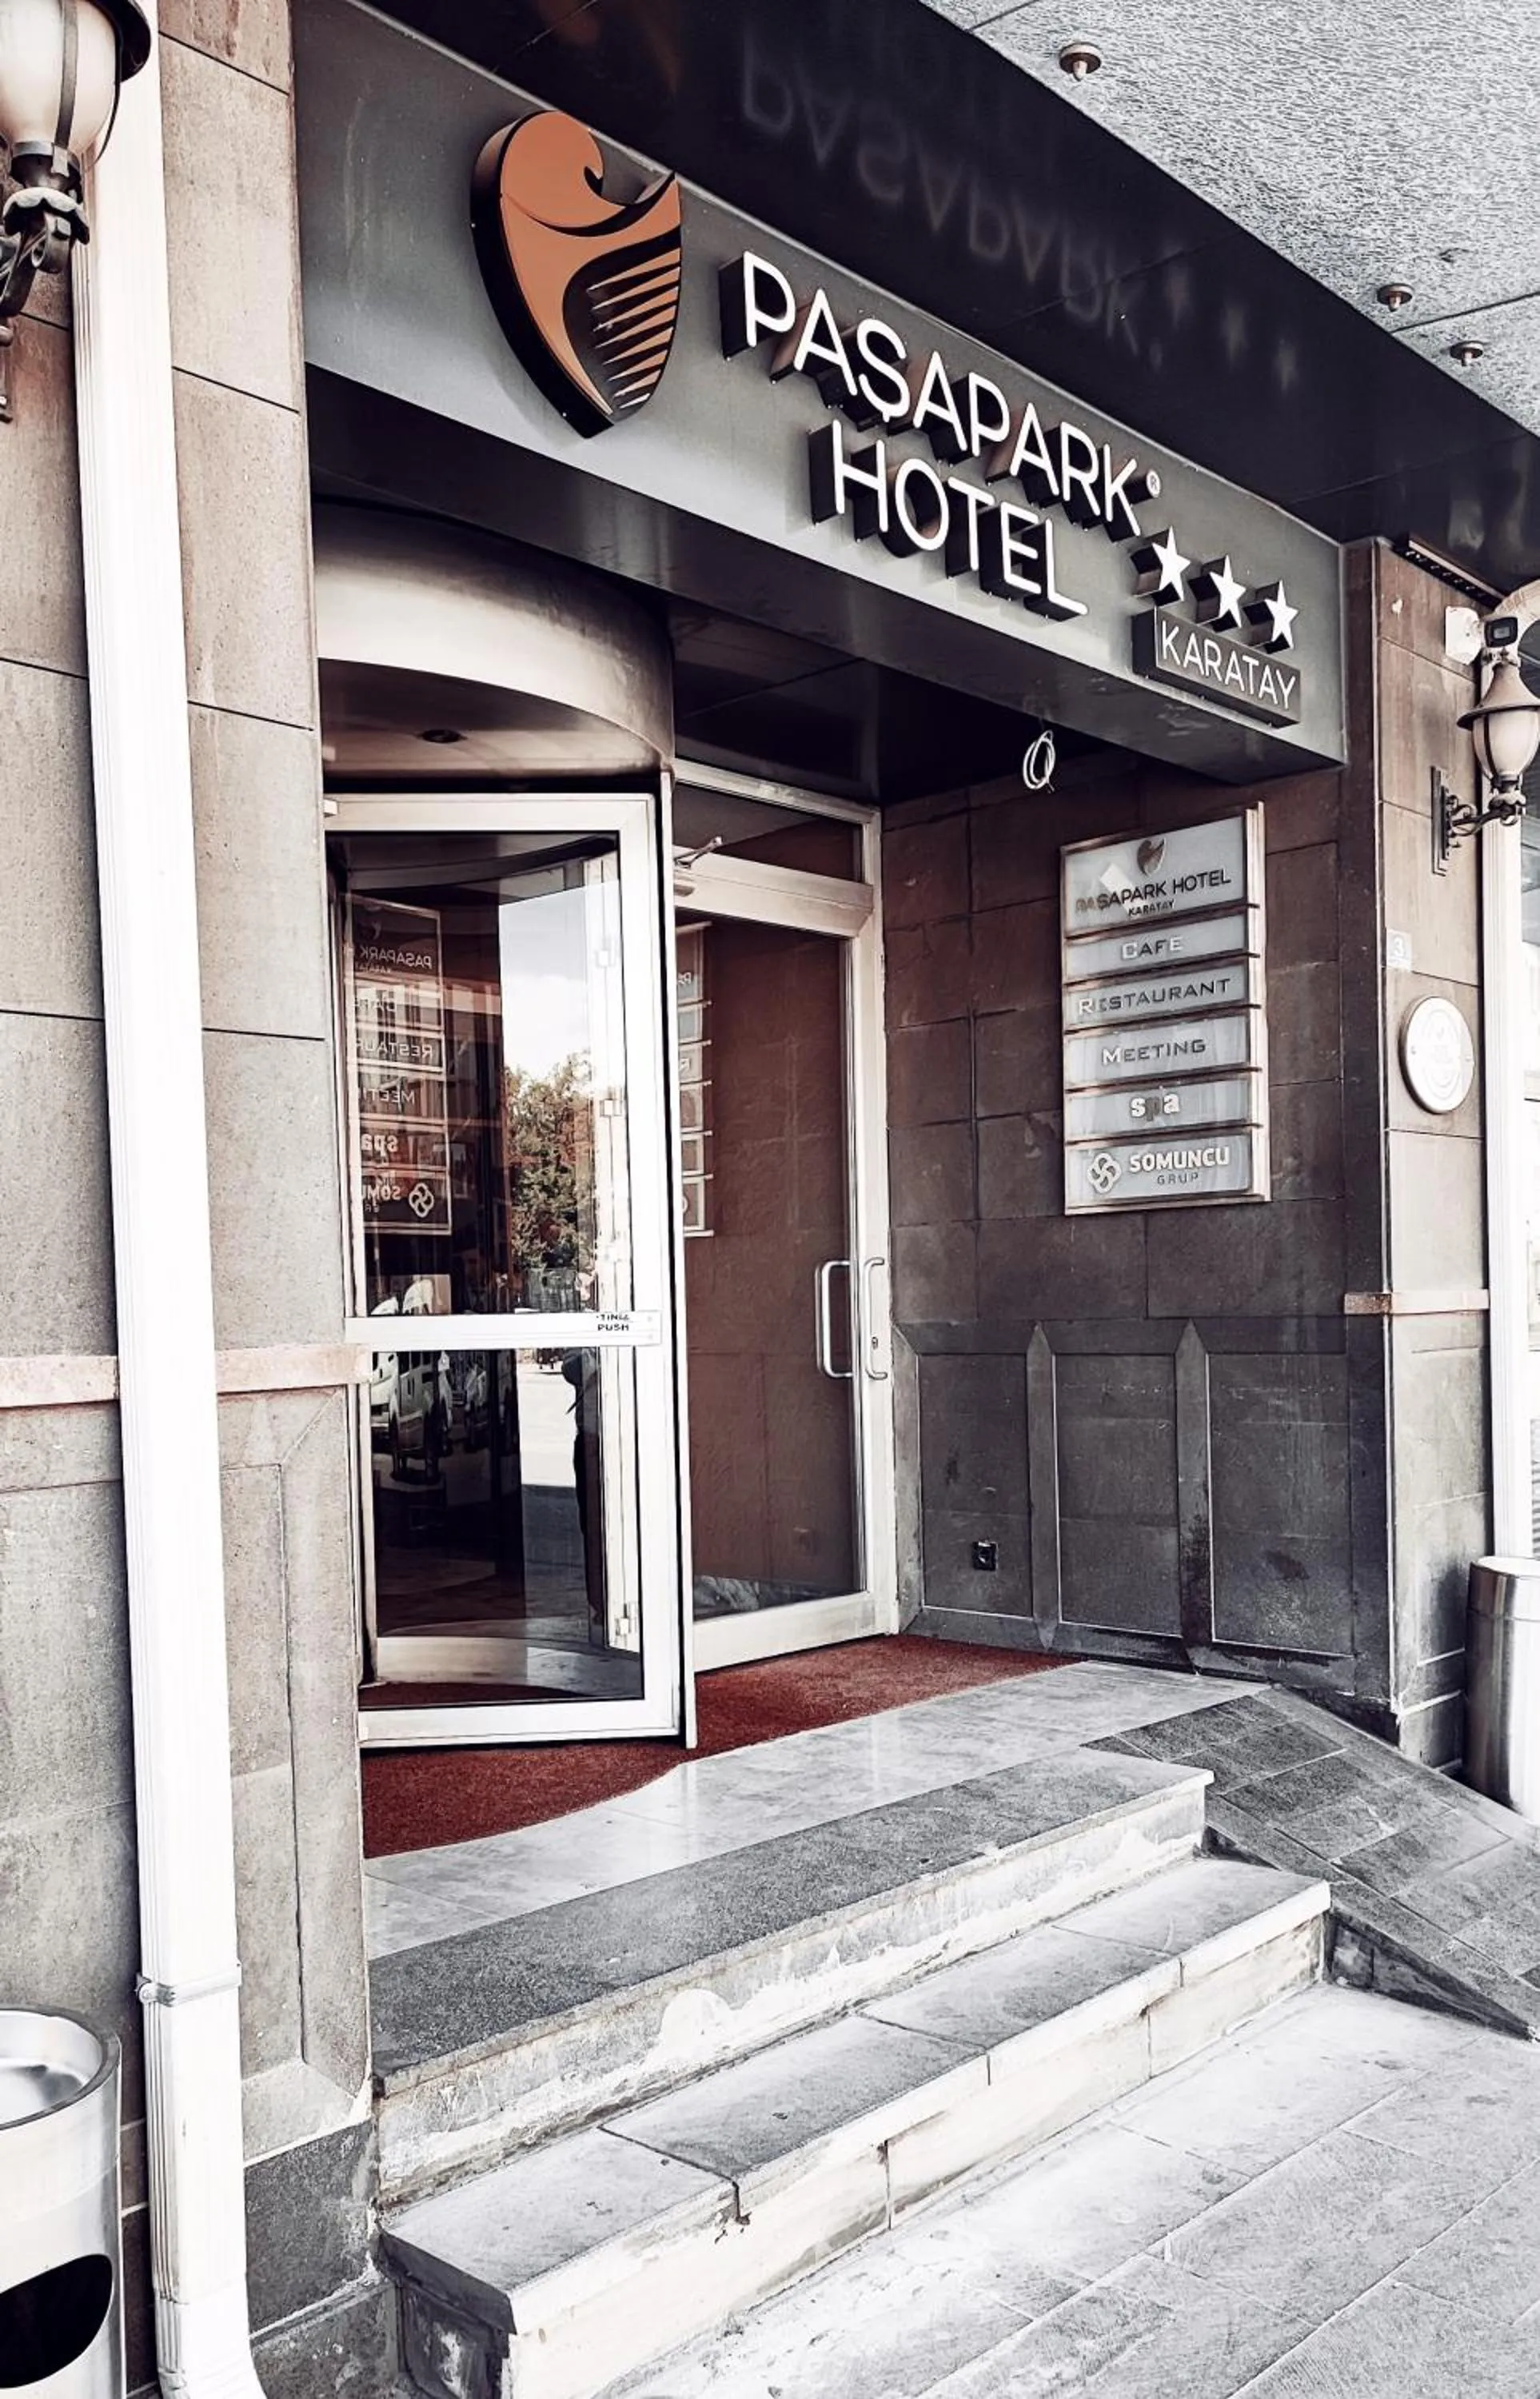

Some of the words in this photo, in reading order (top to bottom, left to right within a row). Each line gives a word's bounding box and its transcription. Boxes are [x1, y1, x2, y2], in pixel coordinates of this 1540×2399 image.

[832, 420, 1088, 616] HOTEL
[1161, 620, 1296, 710] KARATAY
[1173, 868, 1231, 894] HOTEL
[1128, 900, 1175, 916] KARATAY
[1121, 936, 1183, 960] CAFE
[1079, 978, 1231, 1015] RESTAURANT
[1102, 1040, 1206, 1065] MEETING
[1130, 1093, 1180, 1121] spa
[1129, 1147, 1230, 1173] SOMUNCU
[1157, 1172, 1199, 1185] GRUP
